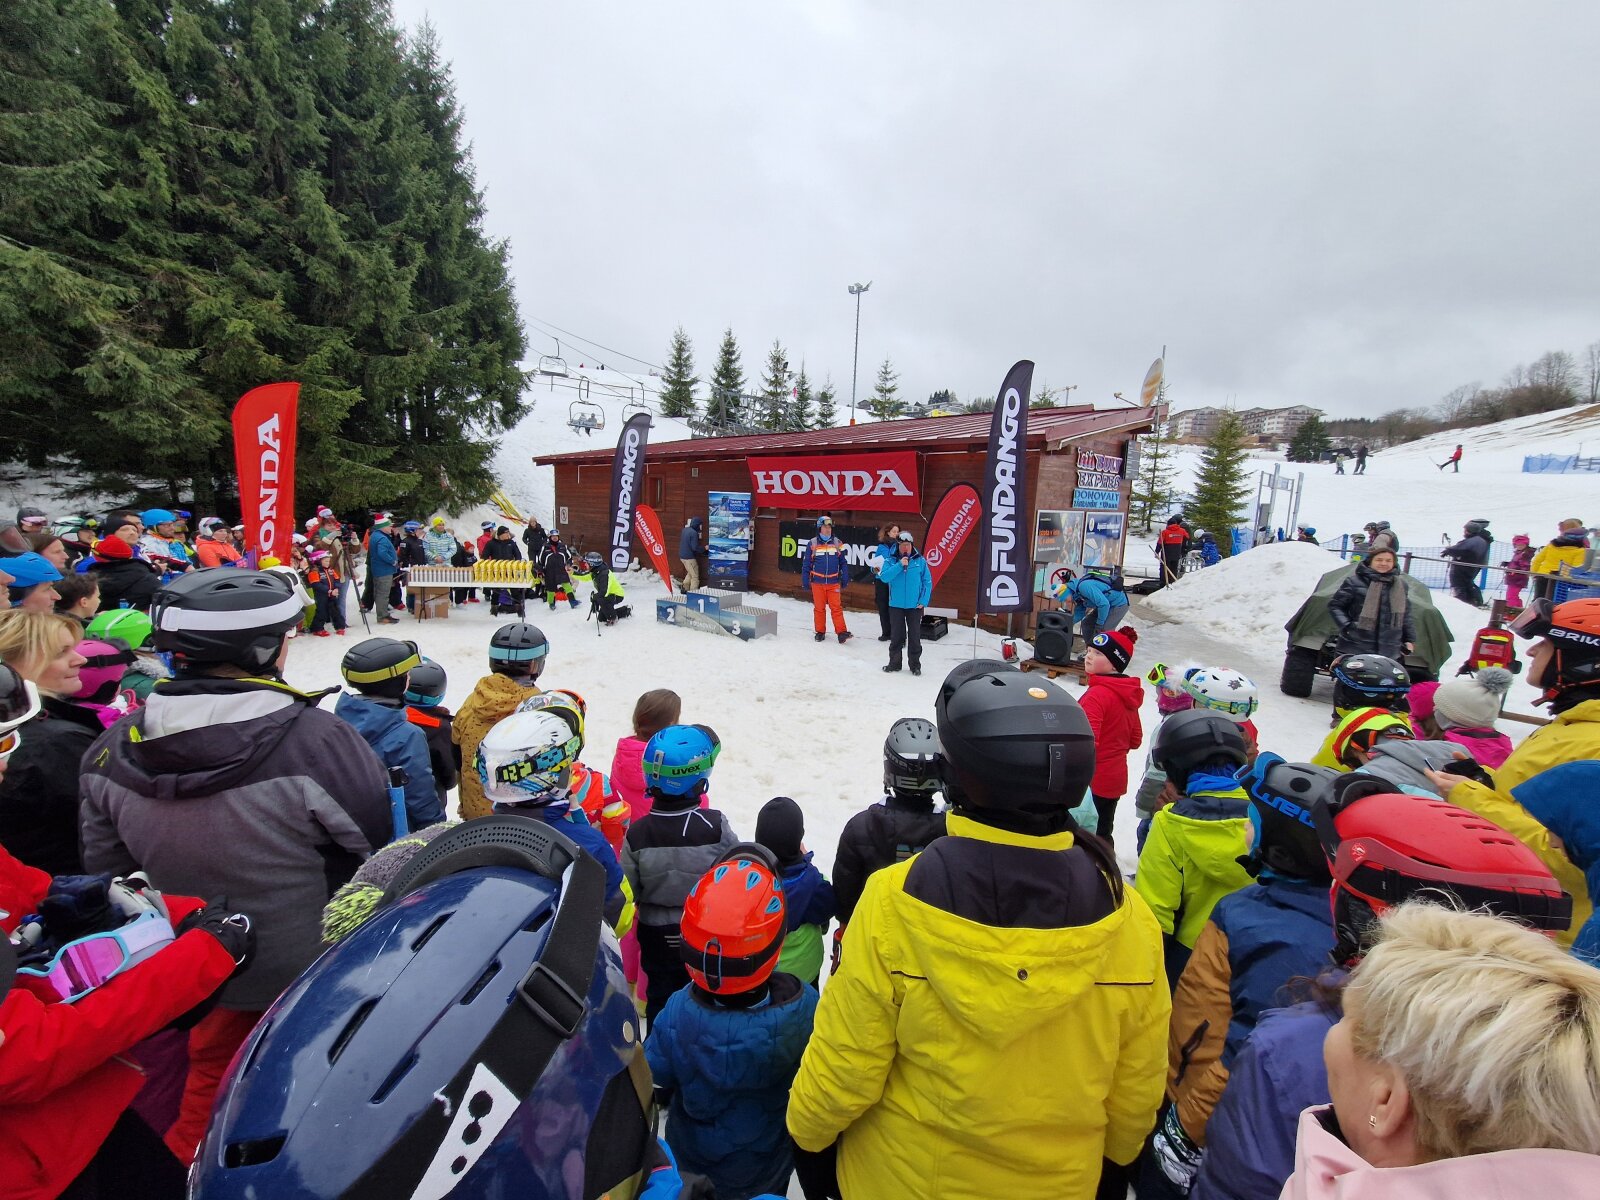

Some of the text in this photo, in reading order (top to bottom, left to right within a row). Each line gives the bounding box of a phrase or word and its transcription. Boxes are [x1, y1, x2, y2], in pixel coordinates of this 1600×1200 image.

[257, 413, 281, 558] ONDA
[753, 470, 914, 496] HONDA
[938, 498, 975, 549] MONDIAL
[947, 515, 973, 554] ASSISTANCE
[666, 607, 675, 622] 2
[697, 598, 705, 614] 1
[731, 619, 741, 635] 3
[671, 764, 701, 776] uvex
